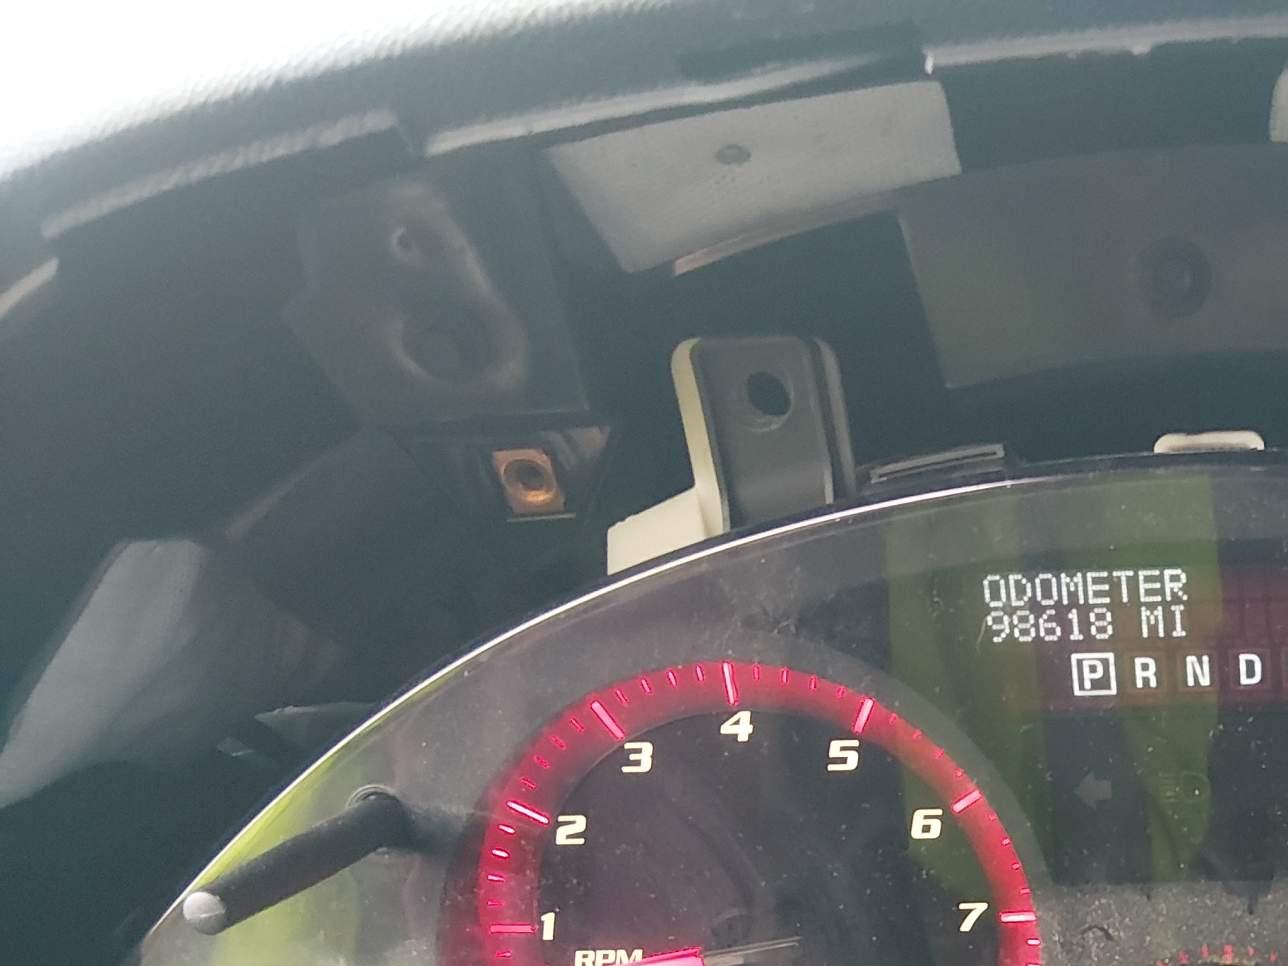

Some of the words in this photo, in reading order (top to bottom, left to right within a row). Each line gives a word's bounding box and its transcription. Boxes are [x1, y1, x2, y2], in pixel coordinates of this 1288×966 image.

[982, 567, 1189, 608] ODOMETER
[985, 607, 1114, 644] 98618
[1140, 604, 1188, 640] MI
[1082, 662, 1104, 690] P
[1134, 656, 1158, 689] R
[1185, 655, 1211, 687] N
[1238, 653, 1263, 685] D
[720, 710, 754, 742] 4
[620, 741, 654, 773] 3
[826, 739, 860, 772] 5
[555, 814, 587, 845] 2
[910, 808, 943, 840] 6
[539, 911, 557, 941] 1
[958, 902, 989, 932] 7
